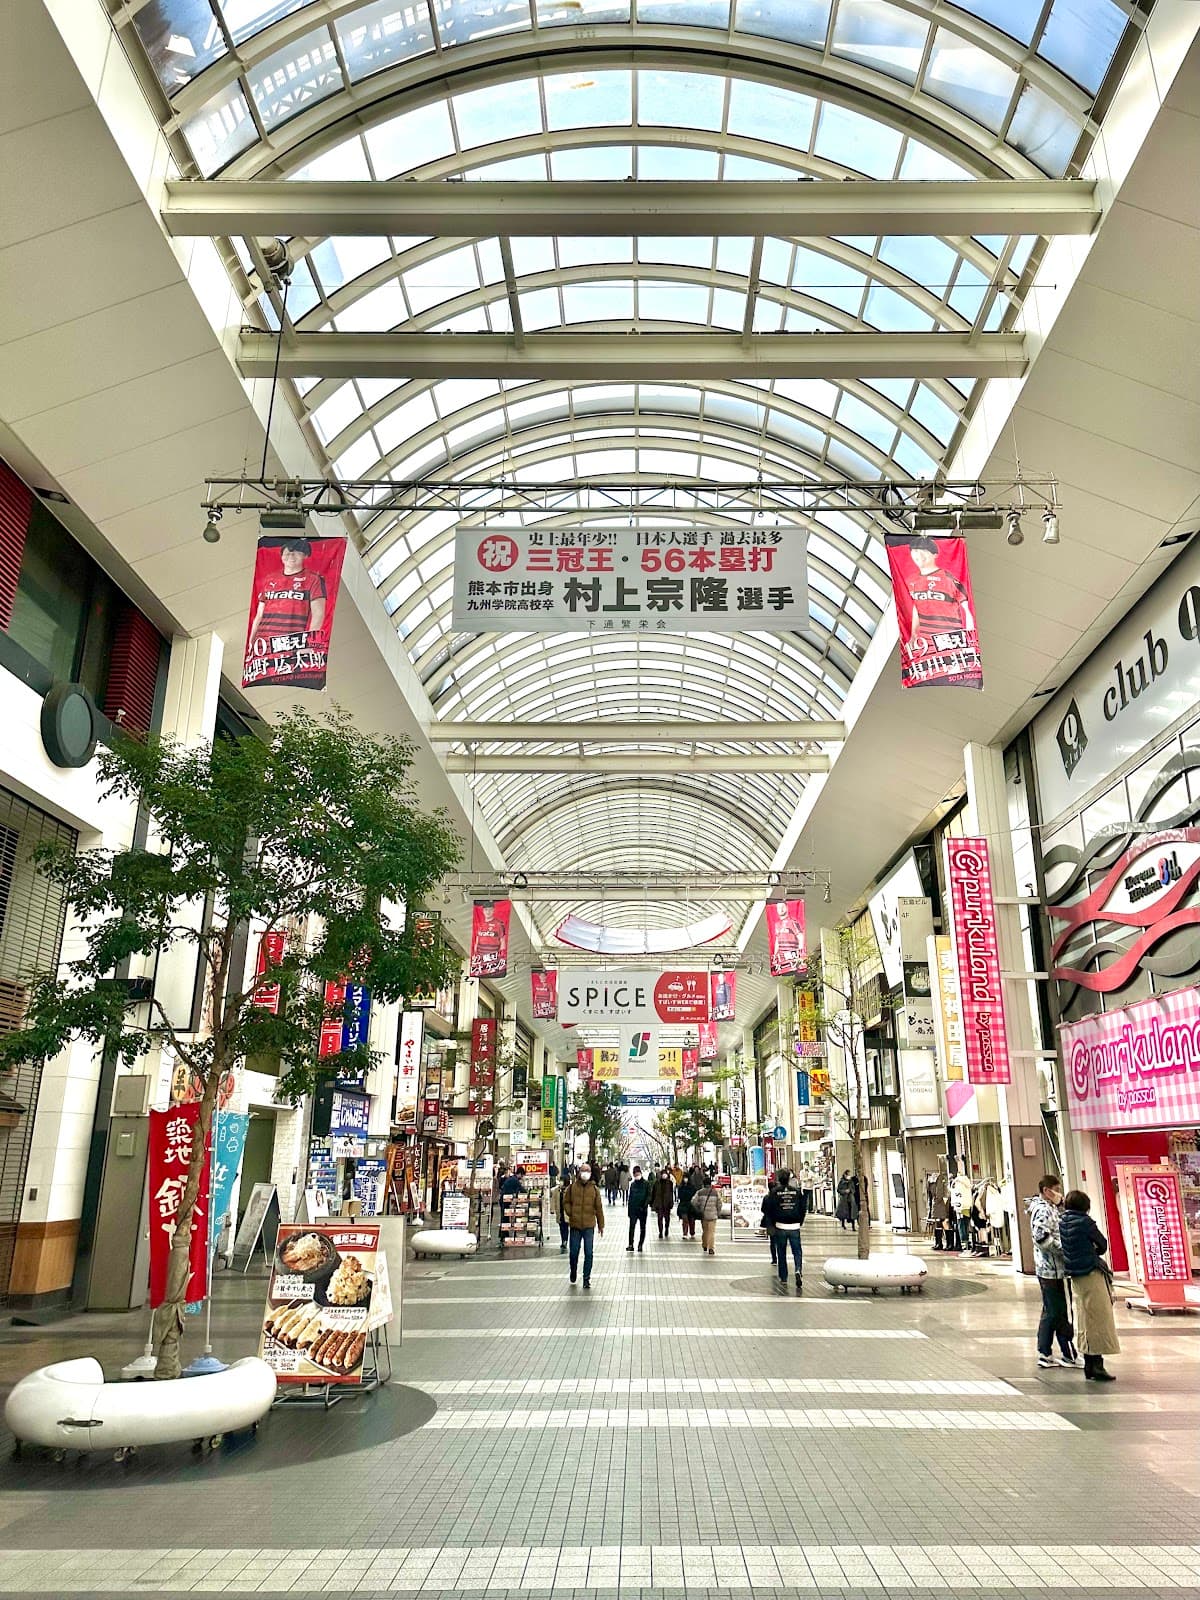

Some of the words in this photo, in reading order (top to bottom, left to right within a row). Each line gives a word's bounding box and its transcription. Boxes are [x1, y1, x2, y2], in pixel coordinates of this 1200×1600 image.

[482, 540, 512, 568] 祝
[636, 532, 714, 546] 日本人選手
[720, 531, 783, 545] 過去最多
[467, 581, 554, 596] 熊本市出身
[467, 599, 555, 611] 九州学院高校卒
[563, 577, 728, 612] 村上宗隆
[737, 587, 794, 610] 選手
[586, 619, 667, 629] 下通繁栄会
[1103, 629, 1169, 722] club
[1064, 714, 1079, 749] Q
[959, 877, 995, 1002] purikuland
[977, 1012, 991, 1030] by
[567, 987, 646, 1007] SPICE
[403, 1039, 415, 1076] やよい軒
[164, 1117, 192, 1165] 築地
[1153, 1206, 1175, 1276] purikuland
